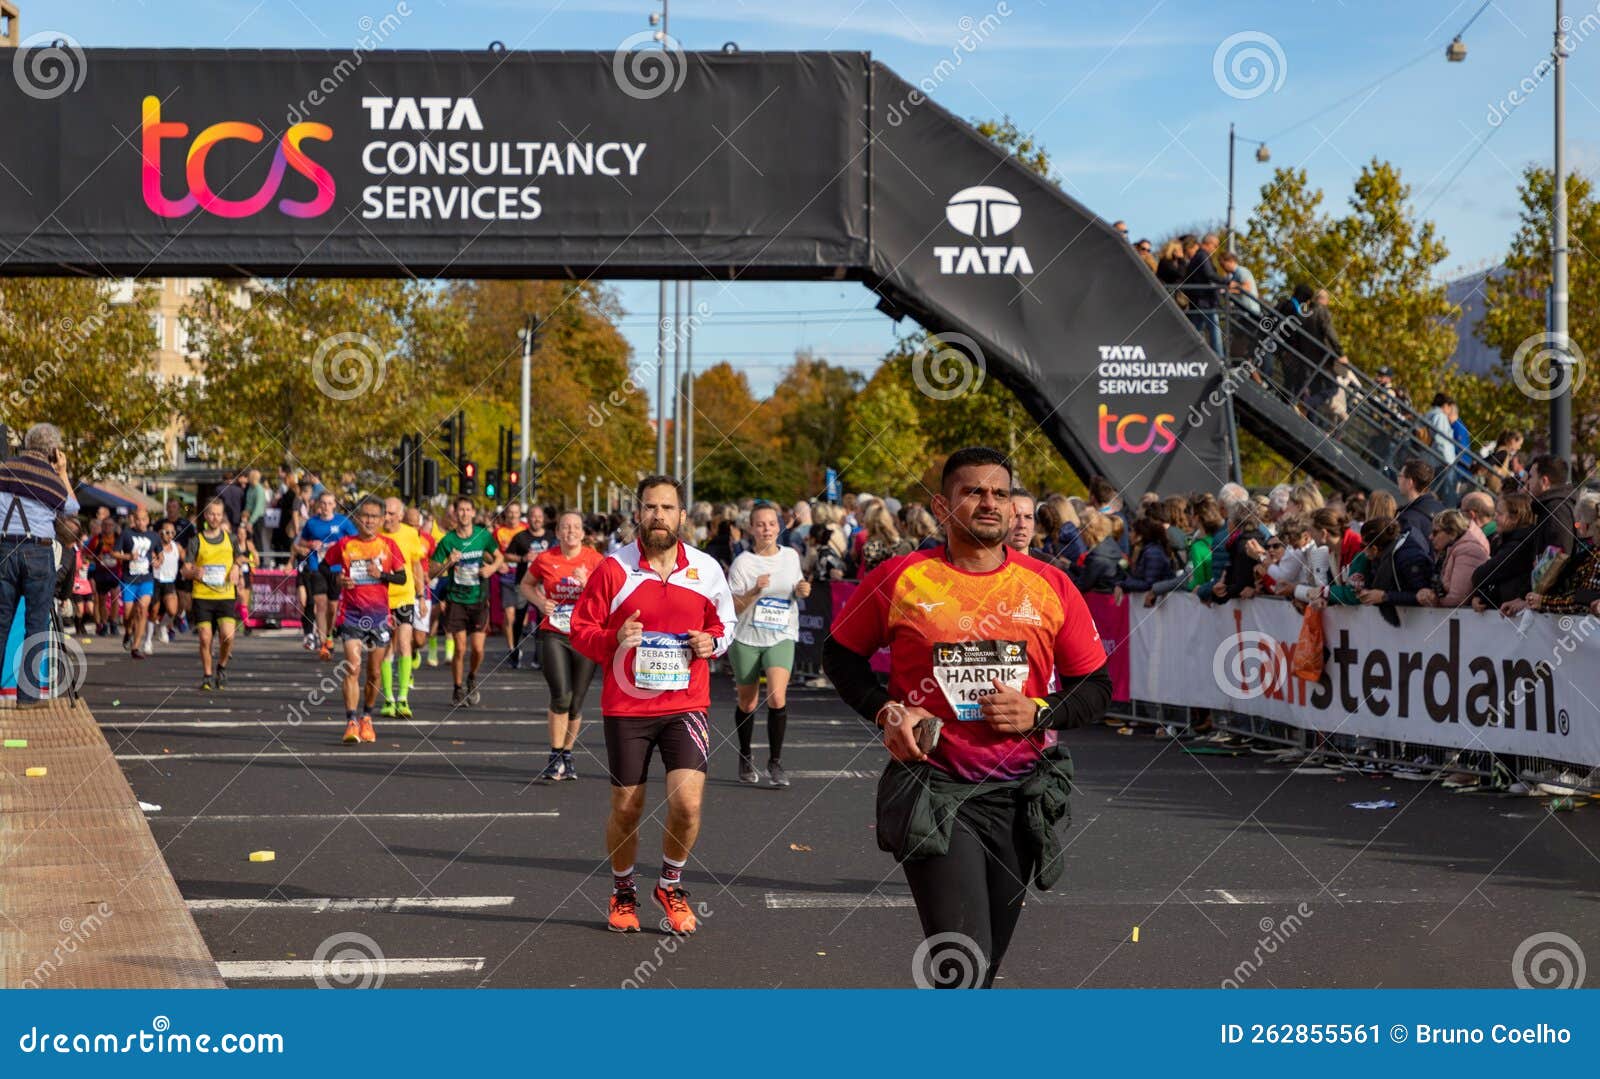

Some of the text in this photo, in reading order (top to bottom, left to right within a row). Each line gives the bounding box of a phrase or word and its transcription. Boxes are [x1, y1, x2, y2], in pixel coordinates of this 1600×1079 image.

[362, 97, 483, 130] TATA
[142, 96, 335, 218] tcs
[363, 141, 646, 176] CONSULTANCY
[363, 186, 542, 220] SERVICES
[933, 246, 1034, 275] TATA
[1099, 345, 1146, 360] TATA
[1099, 362, 1208, 377] CONSULTANCY
[1099, 379, 1169, 395] SERVICES
[1099, 404, 1176, 454] tcs
[641, 649, 689, 659] SEBASTIEN
[650, 661, 680, 671] 25356
[946, 667, 1017, 683] HARDIK
